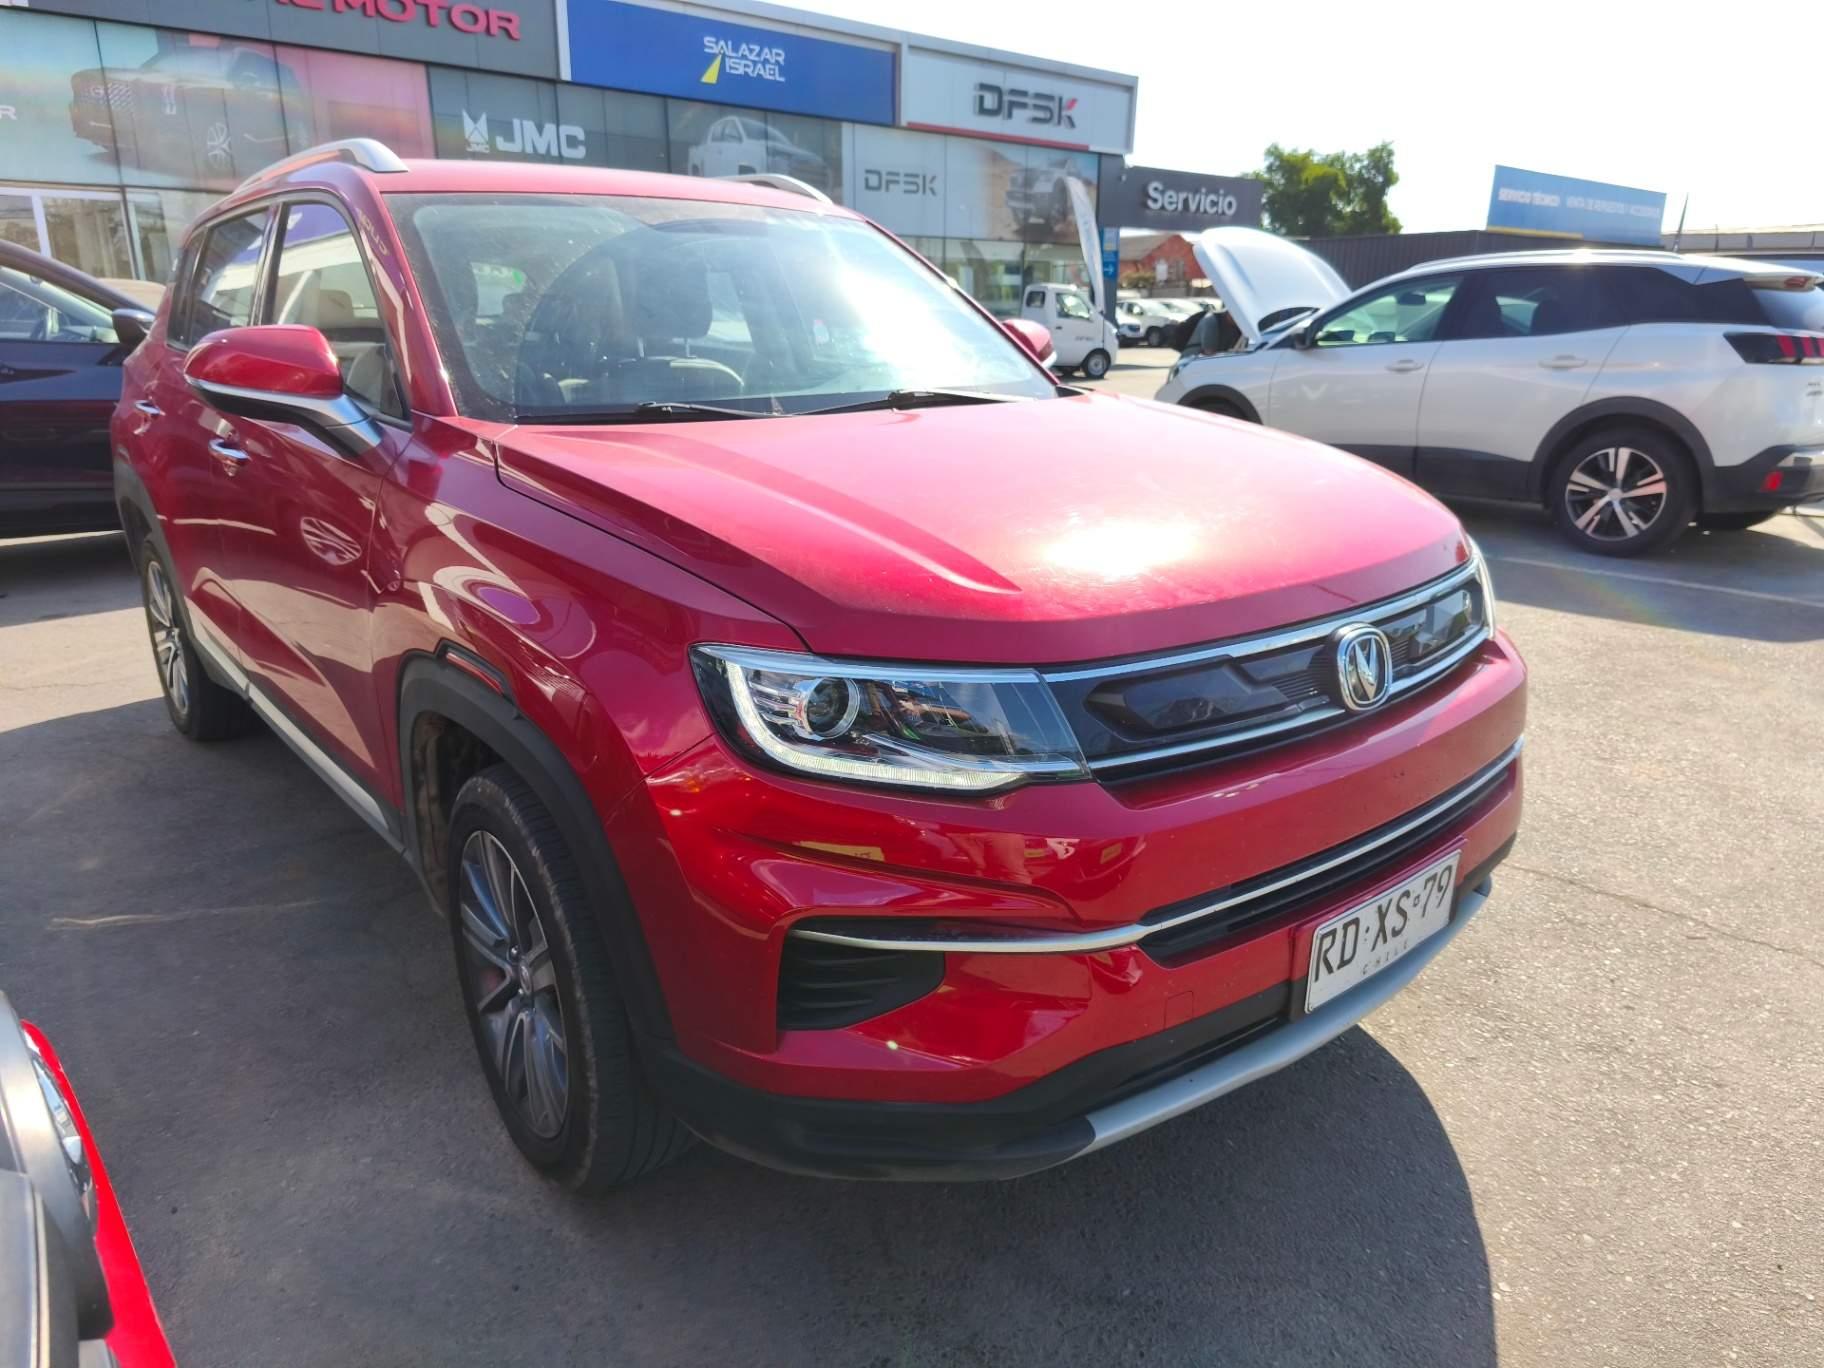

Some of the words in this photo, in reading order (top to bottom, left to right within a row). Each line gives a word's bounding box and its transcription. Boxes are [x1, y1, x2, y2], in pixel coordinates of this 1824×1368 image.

[703, 36, 785, 66] SALAZAR
[725, 56, 785, 82] ISRAEL
[976, 82, 1078, 129] DFSK
[496, 118, 586, 159] JMC
[864, 168, 937, 196] DFSK
[1147, 181, 1237, 216] Servicio
